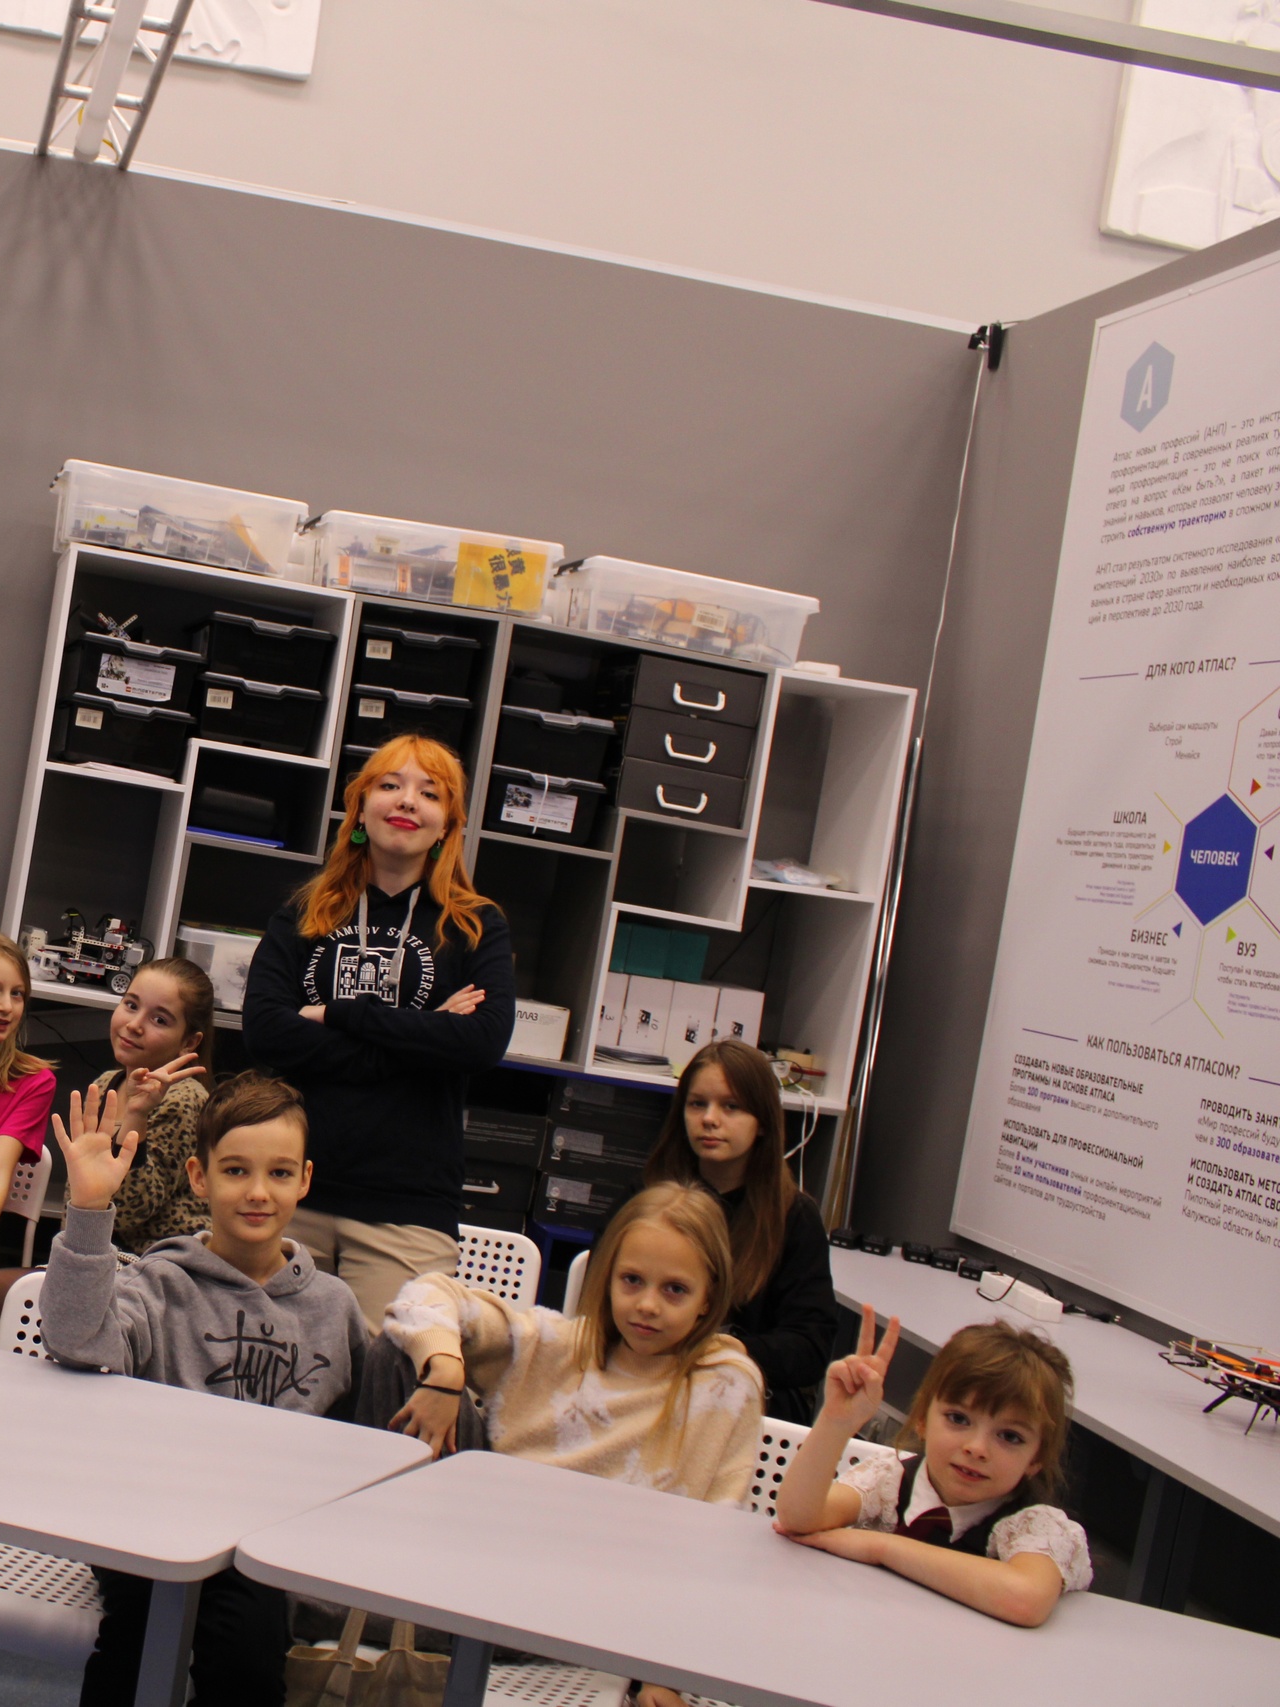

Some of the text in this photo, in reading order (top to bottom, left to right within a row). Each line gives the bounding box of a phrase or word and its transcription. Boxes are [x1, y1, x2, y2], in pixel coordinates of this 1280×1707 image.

[1161, 431, 1200, 450] профессий
[1203, 421, 1227, 440] (АНП)
[1241, 418, 1255, 430] это
[1174, 452, 1179, 463] В
[1182, 441, 1232, 461] современных
[1236, 433, 1269, 448] реалиях
[1129, 469, 1188, 490] профориентация
[1203, 462, 1216, 473] это
[1221, 458, 1231, 468] не
[1237, 452, 1260, 463] поиск
[1106, 500, 1127, 511] ответа
[1131, 497, 1139, 505] на
[1143, 490, 1167, 503] вопрос
[1241, 467, 1264, 480] пакет
[1167, 500, 1198, 515] которые
[1199, 492, 1233, 507] позволят
[1236, 484, 1273, 499] человеку
[1100, 532, 1126, 544] строить
[1128, 521, 1175, 538] собственную
[1178, 510, 1227, 529] траекторию
[1236, 503, 1271, 516] сложном
[1096, 562, 1111, 575] АНП
[1112, 562, 1127, 573] стал
[1128, 555, 1171, 571] результатом
[1172, 547, 1215, 563] системного
[1216, 536, 1273, 554] исследования
[1093, 576, 1136, 591] компетенций
[1167, 570, 1176, 580] по
[1180, 562, 1223, 578] выявлению
[1227, 554, 1266, 569] наиболее
[1122, 591, 1145, 604] стране
[1146, 588, 1164, 600] сфер
[1165, 583, 1202, 596] занятости
[1210, 572, 1264, 590] необходимых
[1088, 600, 1204, 624] ций перспективе до 2030 года.
[1145, 657, 1237, 680] ДЛЯ КОГО АТЛАС?
[1113, 811, 1147, 824] ШКОЛА
[1190, 849, 1240, 866] ЧЕЛОВЕК
[1130, 929, 1169, 946] БИЗНЕС
[1236, 941, 1257, 957] ВУЗ
[1087, 1034, 1241, 1080] КАК ПОЛЬЗОВАТЬСЯ АТЛАСОМ?
[1012, 1068, 1115, 1102] ПРОГРАММЫ НА ОСНОВЕ АТЛАСА
[1014, 1054, 1144, 1094] СОЗДАВАТЬ НОВЫЕ ОБРАЗОВАТЕЛЬНЫЕ
[1009, 1081, 1159, 1130] Более 100 программ высшего дополнительного
[1200, 1098, 1280, 1129] ПРОВОДИТЬ ЗАНЯ
[1001, 1132, 1038, 1151] НАВИГАЦИИ
[1003, 1118, 1144, 1168] ИСПОЛЬЗОВАТЬ ДЛЯ ПРОФЕССИОНАЛЬНОЙ
[1198, 1116, 1217, 1130] «Мир
[1220, 1122, 1260, 1140] профессий
[1195, 1133, 1280, 1163] чем 300 образовате
[998, 1146, 1162, 1207] Более млн участников очных онлайн мероприятий
[1190, 1157, 1255, 1186] ИСПОЛЬЗОВАТЬ
[996, 1159, 1013, 1172] Более
[1022, 1170, 1034, 1180] млн
[1035, 1174, 1082, 1196] пользователей
[1083, 1190, 1150, 1220] профориентационных
[1017, 1183, 1043, 1198] порталов
[1044, 1192, 1055, 1201] для
[1056, 1196, 1106, 1221] трудоустройства
[1187, 1173, 1263, 1206] И СОЗДАТЬ АТЛАС
[1181, 1205, 1221, 1228] Калужской
[1222, 1220, 1253, 1238] области
[1255, 1229, 1271, 1245] был
[1184, 1189, 1278, 1229] Пилотный региональный
